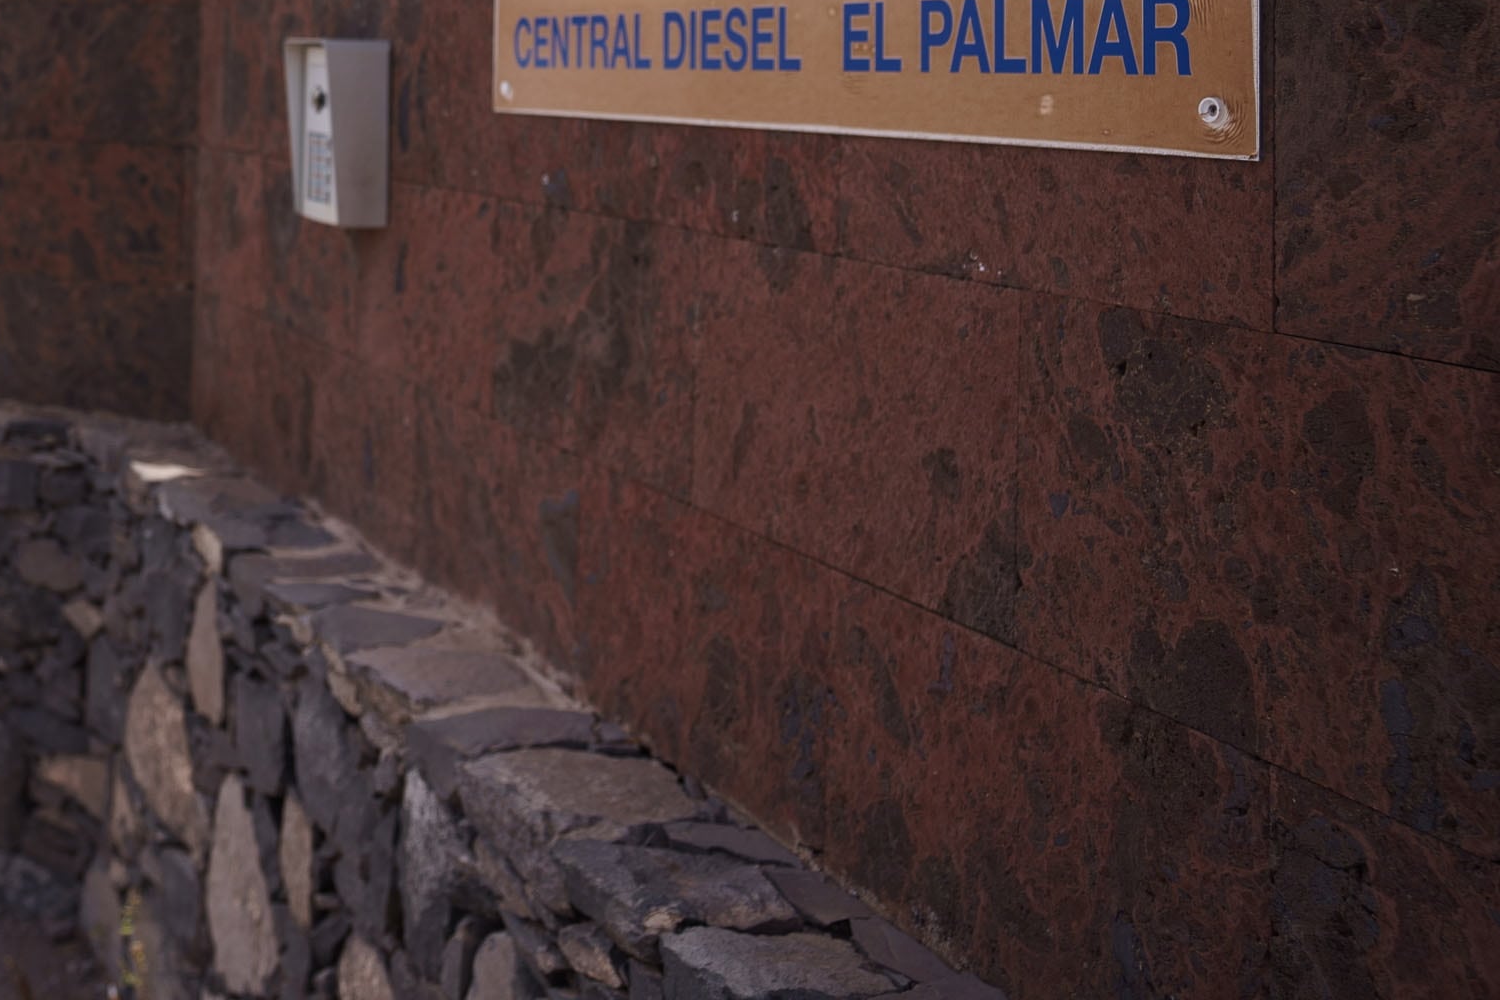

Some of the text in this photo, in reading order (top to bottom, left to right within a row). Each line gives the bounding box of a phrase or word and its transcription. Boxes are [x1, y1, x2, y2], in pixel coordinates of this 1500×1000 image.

[514, 12, 652, 70] CENTRAL
[663, 6, 802, 72] DIESEL
[843, 1, 902, 73] EL
